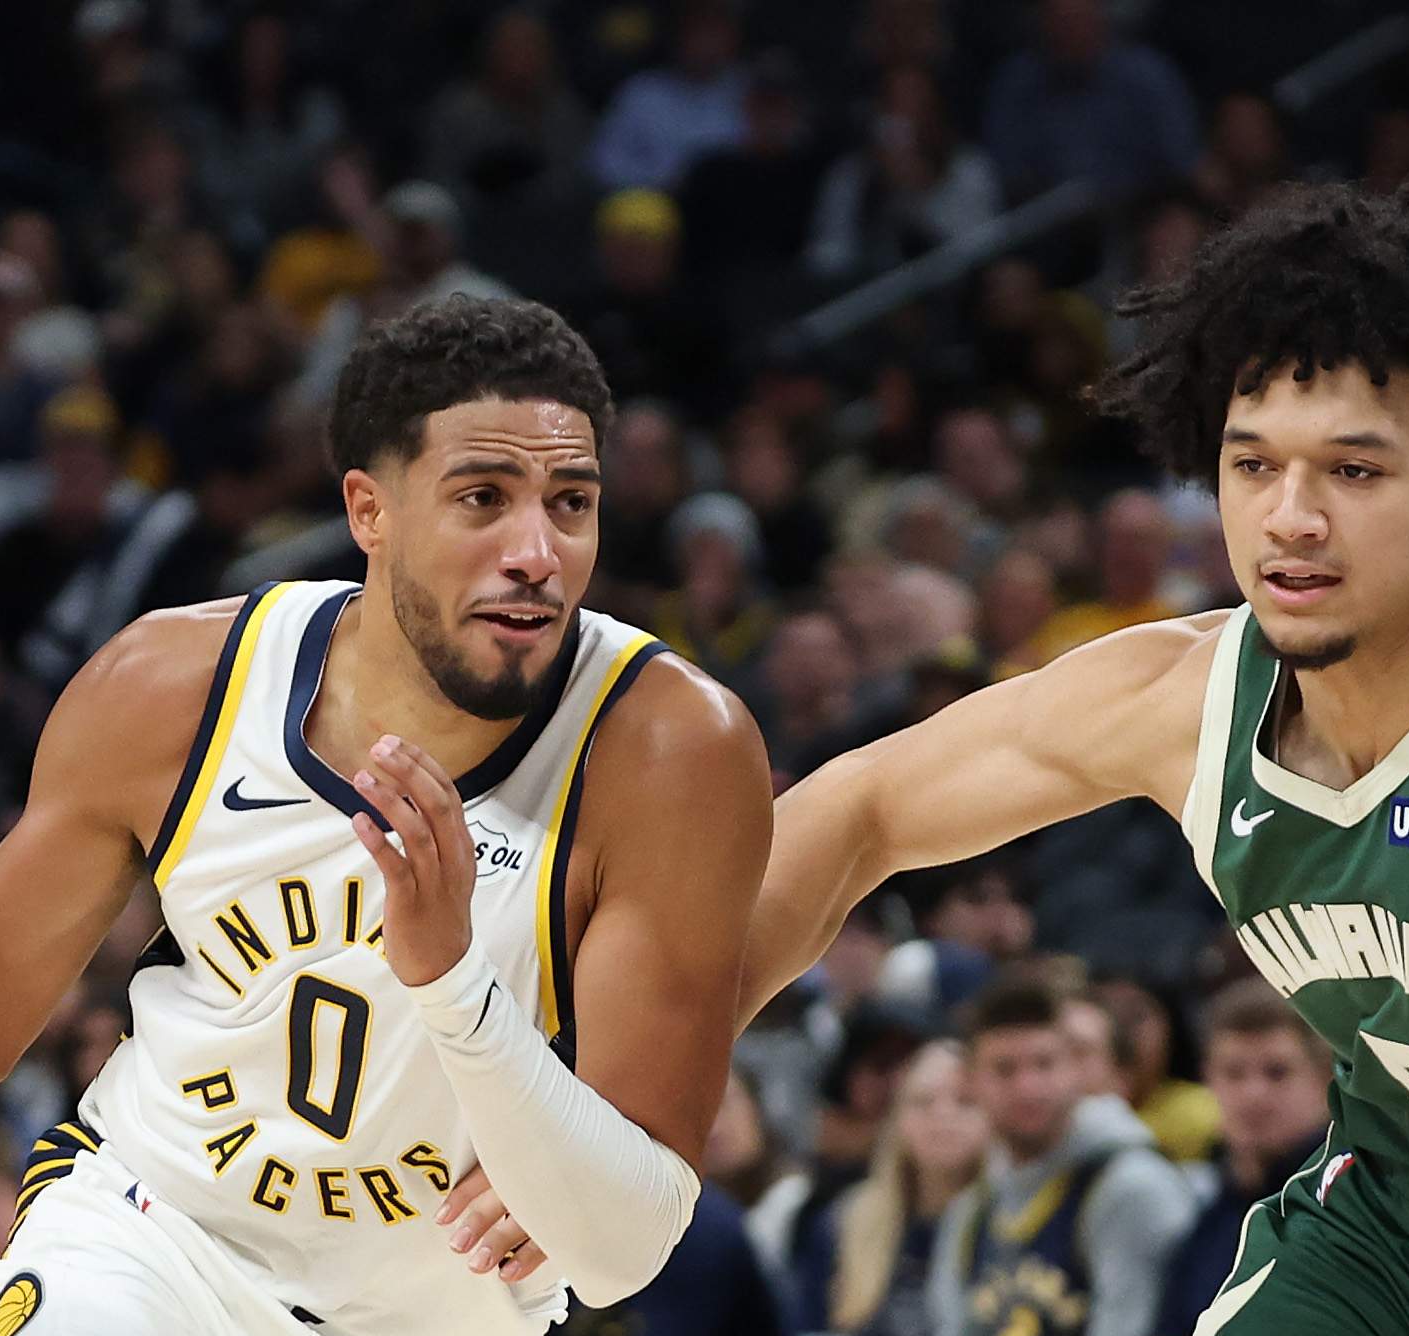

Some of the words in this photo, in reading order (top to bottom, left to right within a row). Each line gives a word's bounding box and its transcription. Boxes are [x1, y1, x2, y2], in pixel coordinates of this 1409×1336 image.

[491, 846, 522, 870] OIL
[197, 876, 389, 999] INDI
[287, 970, 374, 1144] 0
[178, 1065, 454, 1226] PACERS
